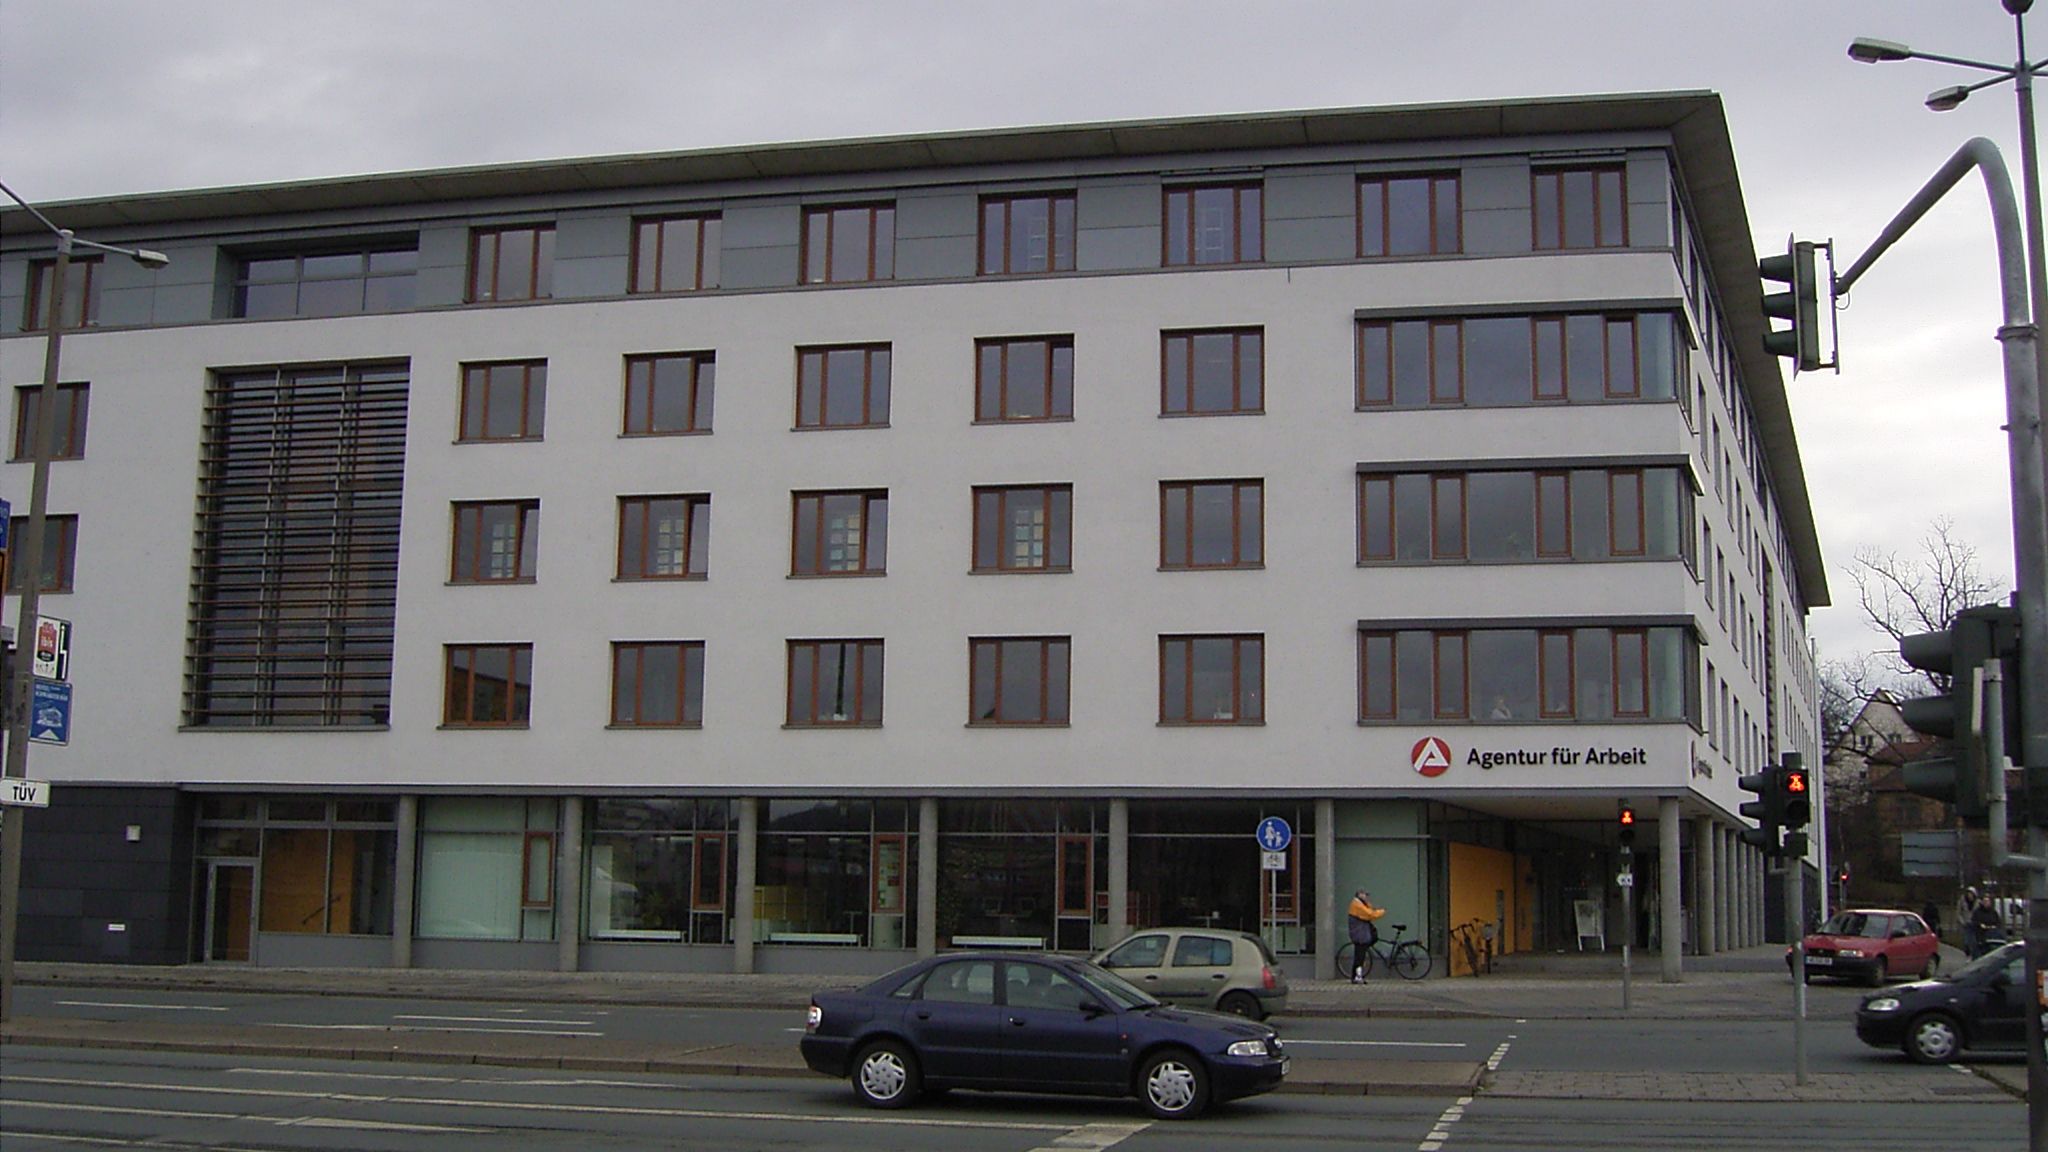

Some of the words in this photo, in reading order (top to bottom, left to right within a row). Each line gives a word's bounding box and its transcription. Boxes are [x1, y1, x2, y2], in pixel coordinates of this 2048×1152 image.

[1467, 747, 1547, 770] Agentur
[1551, 747, 1580, 765] für
[1585, 747, 1647, 765] Arbeit
[13, 782, 36, 801] TÜV
